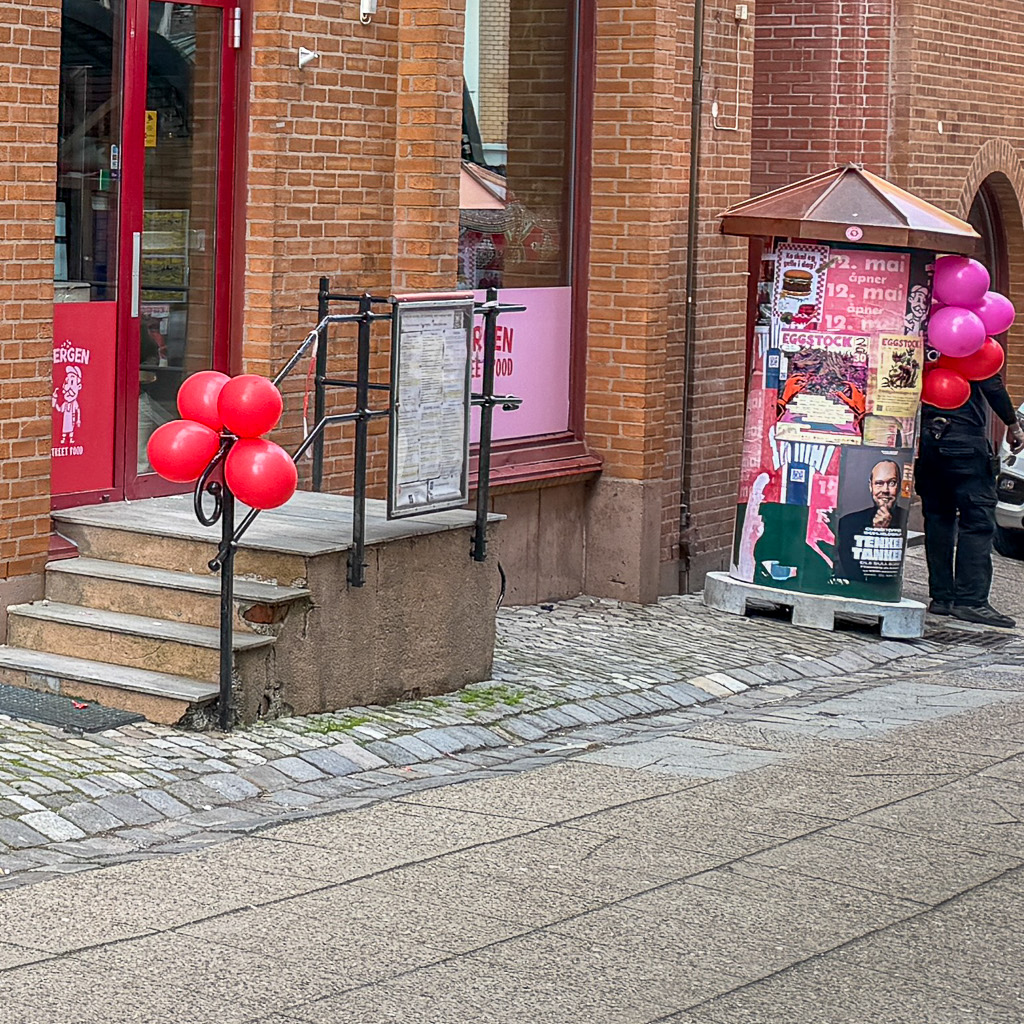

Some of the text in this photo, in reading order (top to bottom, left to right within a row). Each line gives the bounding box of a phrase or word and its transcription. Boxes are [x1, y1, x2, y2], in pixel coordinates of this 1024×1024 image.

[865, 255, 905, 273] mai
[848, 272, 887, 285] åpner
[827, 283, 903, 301] 12. mai
[847, 303, 884, 316] åpner
[825, 314, 853, 330] 12.
[783, 333, 853, 347] EGGSTOCK
[882, 338, 922, 349] EGGSTOCK
[53, 347, 90, 365] ERGEN
[494, 358, 513, 377] OOD
[51, 447, 69, 457] TREET
